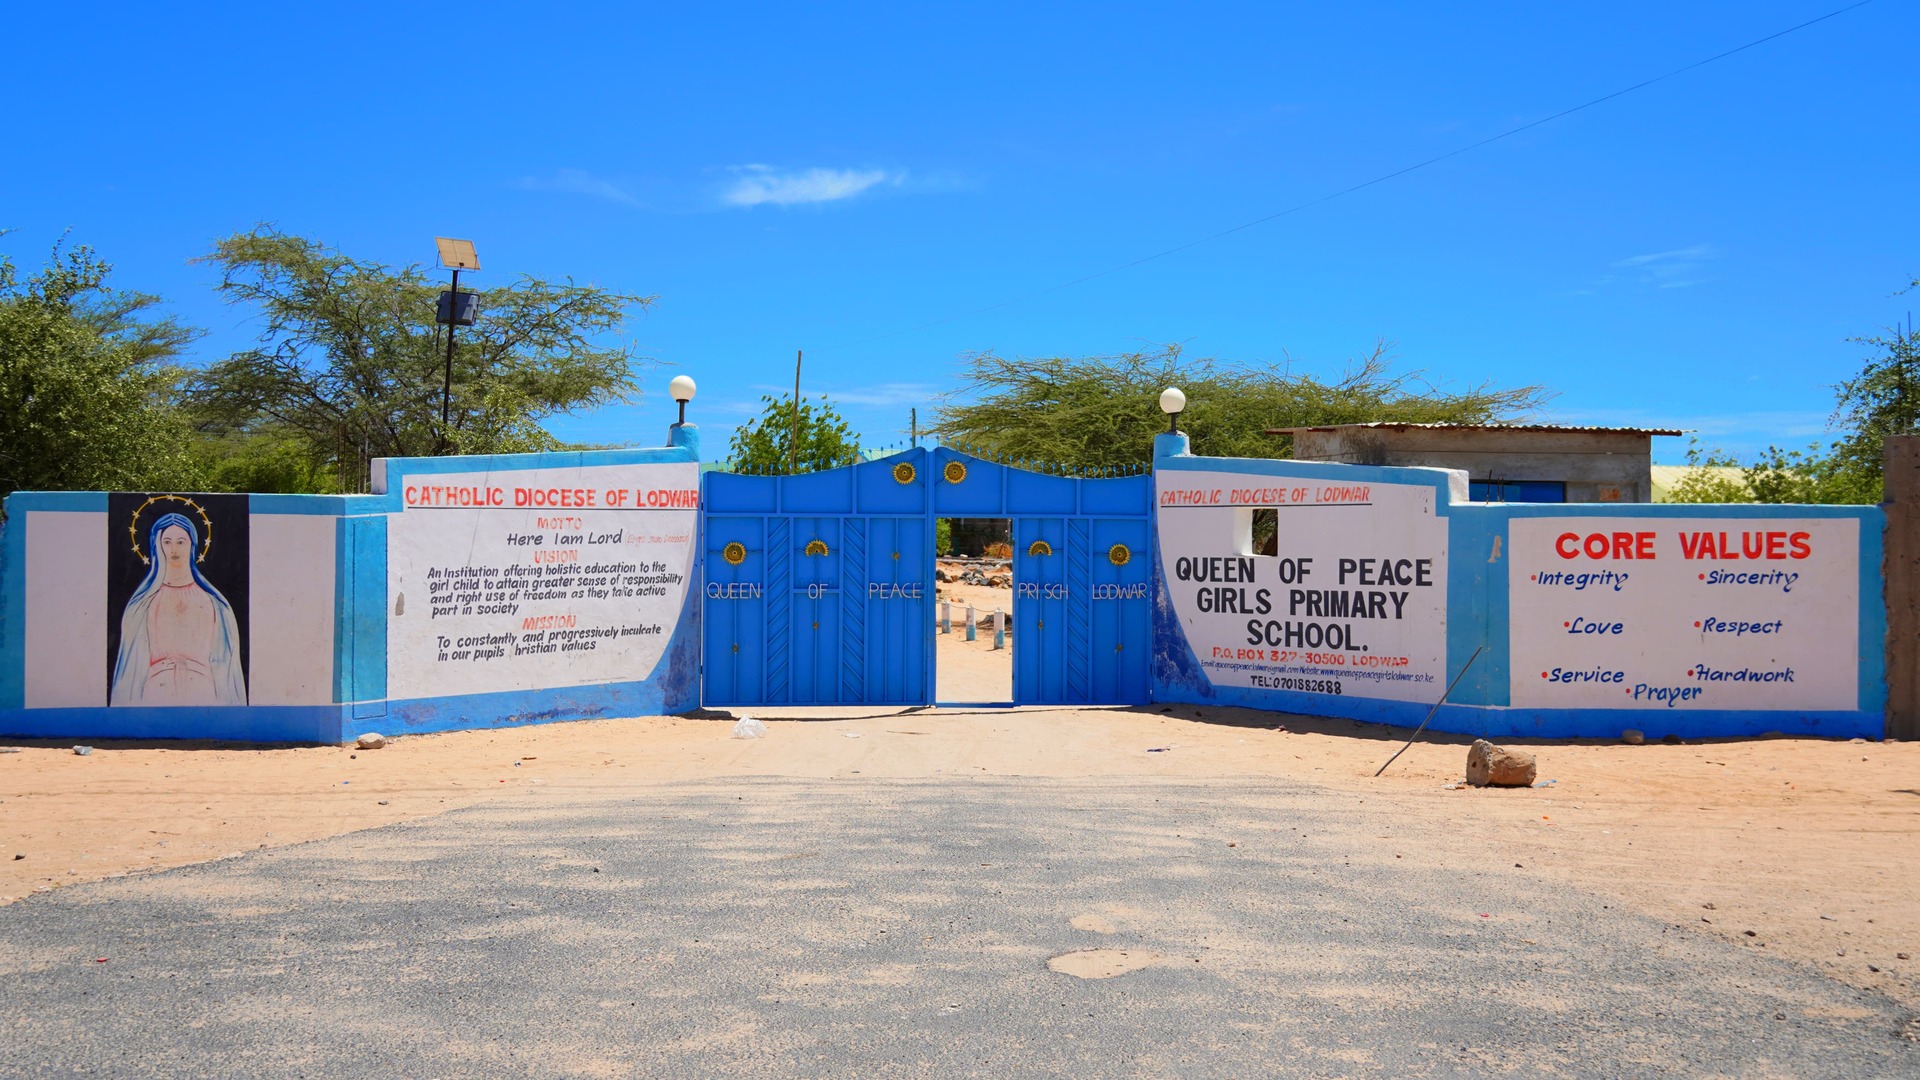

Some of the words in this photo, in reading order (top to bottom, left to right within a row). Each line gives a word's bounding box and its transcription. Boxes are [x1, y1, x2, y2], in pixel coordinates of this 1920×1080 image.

[405, 486, 504, 506] CATHOLIC
[515, 488, 597, 507] DIOCESE
[605, 489, 629, 507] OF
[637, 490, 698, 508] LODWAR
[1160, 489, 1222, 505] CATHOLIC
[1230, 487, 1287, 504] DIOCESE
[1292, 487, 1310, 503] OF
[1315, 486, 1371, 503] LODWAR
[537, 517, 582, 530] MOTTO
[507, 533, 543, 546] Here
[588, 528, 623, 545] Lord
[1555, 532, 1656, 560] CORE
[1679, 531, 1811, 560] VALUES
[534, 550, 578, 564] VISION
[427, 567, 442, 579] An
[443, 566, 499, 579] Institution
[503, 564, 542, 578] offering
[545, 563, 581, 577] holistic
[584, 562, 636, 575] education
[640, 561, 650, 573] to
[652, 561, 667, 573] the
[1175, 556, 1255, 582] QUEEN
[1279, 558, 1313, 584] OF
[1339, 558, 1433, 587] PEACE
[1707, 568, 1798, 592] Sincerity
[430, 579, 449, 594] girl
[453, 579, 480, 591] child
[484, 578, 494, 590] to
[496, 577, 529, 589] attain
[532, 575, 575, 591] greater
[577, 576, 607, 587] sense
[610, 573, 621, 586] of
[622, 573, 683, 587] responsibility
[1538, 570, 1629, 591] Integrity
[430, 592, 454, 604] and
[456, 590, 482, 605] right
[485, 591, 506, 602] use
[509, 589, 521, 601] of
[523, 588, 567, 601] freedom
[571, 590, 584, 599] as
[587, 586, 610, 600] they
[612, 586, 633, 598] take
[636, 585, 667, 597] active
[706, 582, 761, 599] QUEEN
[808, 583, 829, 600] OF
[869, 582, 922, 599] PEACE
[1092, 582, 1148, 600] LODWAR
[432, 604, 458, 619] part
[462, 603, 473, 615] in
[477, 602, 520, 616] society
[1196, 587, 1272, 615] GIRLS
[1289, 589, 1409, 619] PRIMARY
[522, 614, 577, 631] MISSION
[1568, 617, 1624, 634] Love
[1703, 617, 1783, 636] Respect
[437, 635, 451, 648] To
[457, 632, 518, 648] constantly
[522, 630, 544, 643] and
[548, 626, 619, 644] progressively
[1246, 619, 1368, 652] SCHOOL.
[438, 649, 448, 661] in
[451, 649, 471, 660] our
[473, 645, 505, 662] pupils
[561, 640, 597, 652] values
[1212, 646, 1234, 660] P.O.
[1237, 648, 1265, 661] BOX
[1352, 655, 1409, 668] LODWAR
[1549, 666, 1624, 683] Service
[1695, 663, 1795, 683] Hardwork
[1633, 684, 1702, 707] Prayer
